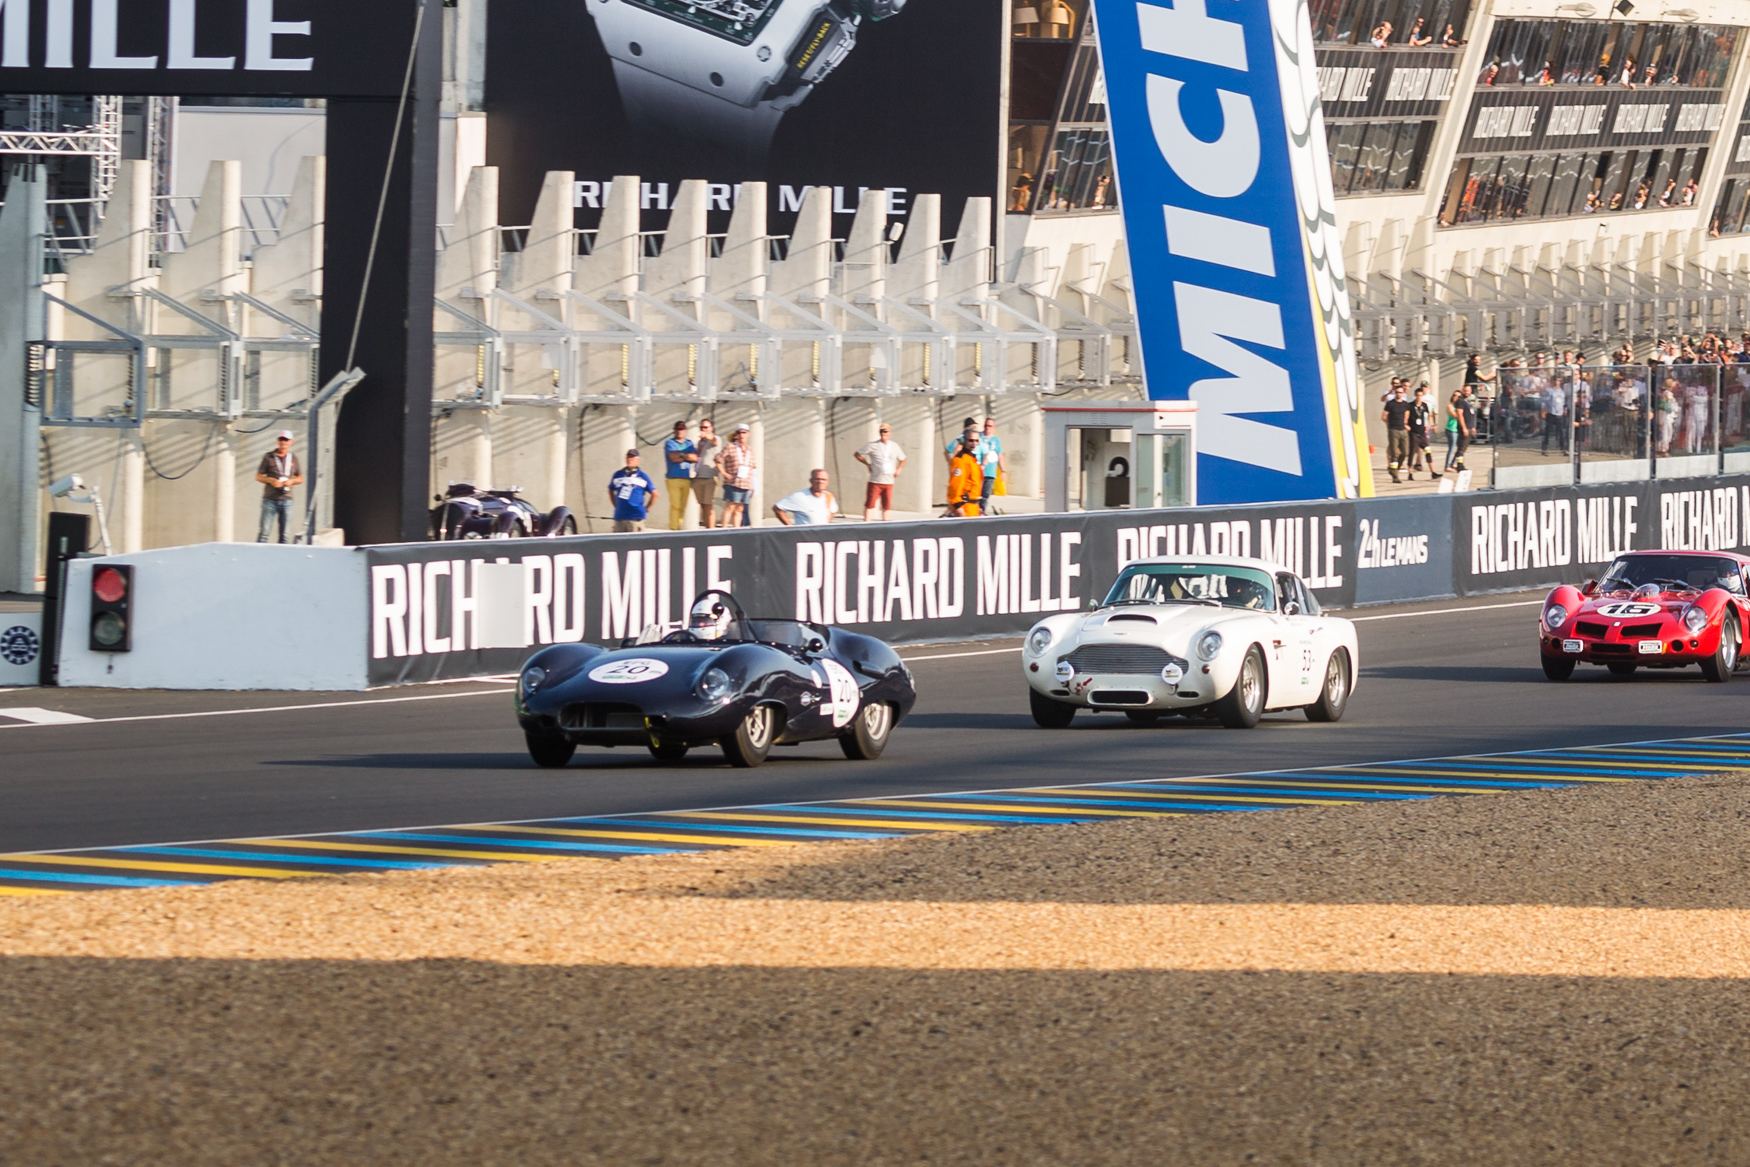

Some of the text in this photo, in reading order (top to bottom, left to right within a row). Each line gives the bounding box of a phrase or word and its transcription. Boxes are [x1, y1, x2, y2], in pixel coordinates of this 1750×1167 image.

[1471, 496, 1638, 574] RICHARD MILLE
[1661, 487, 1738, 550] RICHARD
[796, 532, 1082, 625] RICHARD MILLE
[372, 553, 586, 649] RICHRD
[1606, 603, 1652, 615] 16
[606, 665, 649, 675] 20
[1302, 649, 1312, 671] 53
[837, 678, 852, 703] 20
